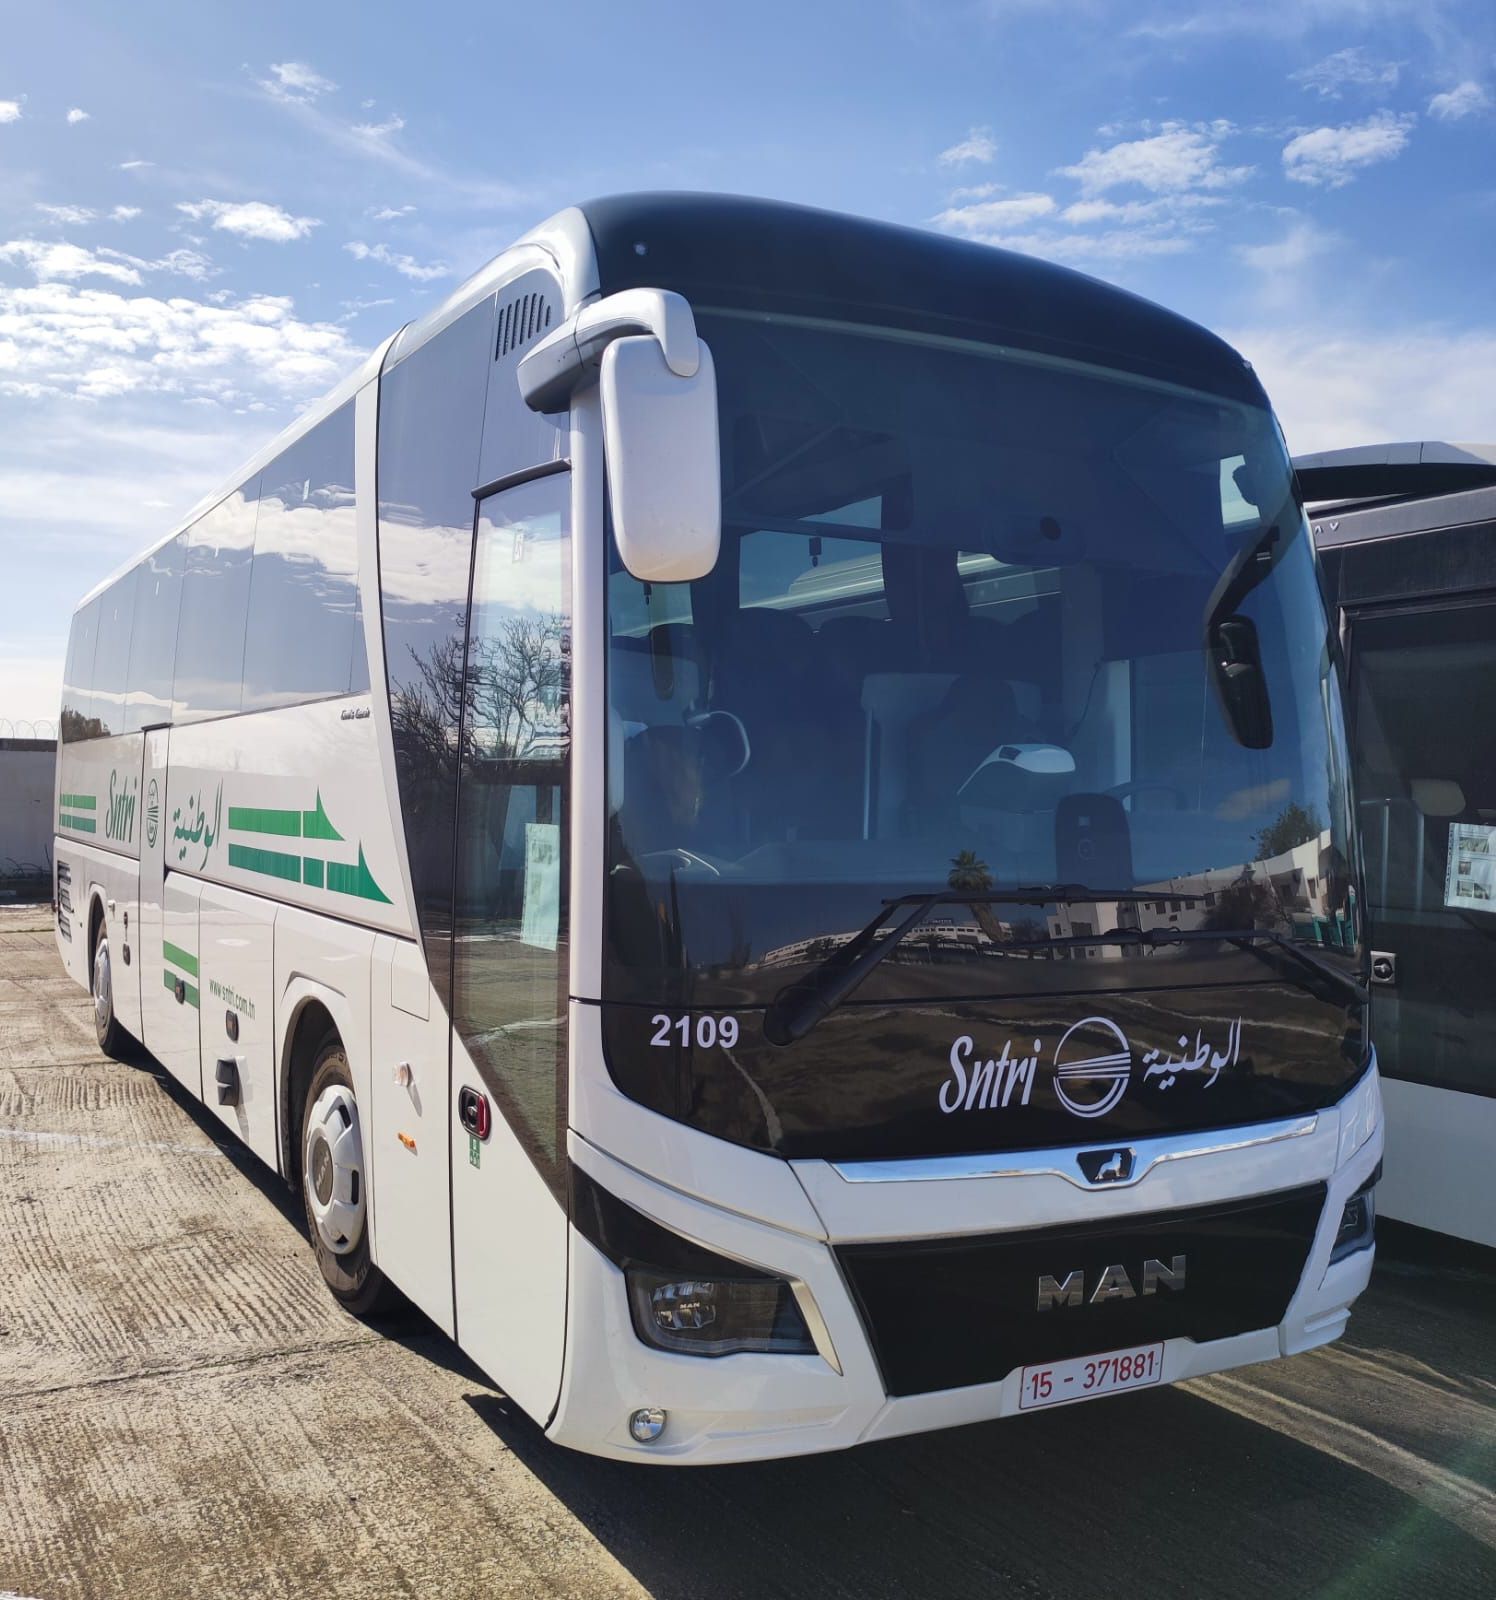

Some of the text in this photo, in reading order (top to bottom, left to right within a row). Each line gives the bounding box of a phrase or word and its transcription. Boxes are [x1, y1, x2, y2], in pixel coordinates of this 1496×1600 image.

[105, 768, 138, 843] Sntri
[172, 775, 224, 872] الوطنية
[208, 978, 256, 1020] www.sntri.com.tn
[650, 1014, 739, 1048] 2109
[938, 1034, 1042, 1114] Sntri
[1142, 1015, 1242, 1090] الوطنية
[1036, 1254, 1187, 1312] MAN
[1031, 1371, 1053, 1400] 15
[1082, 1350, 1155, 1389] 371881
